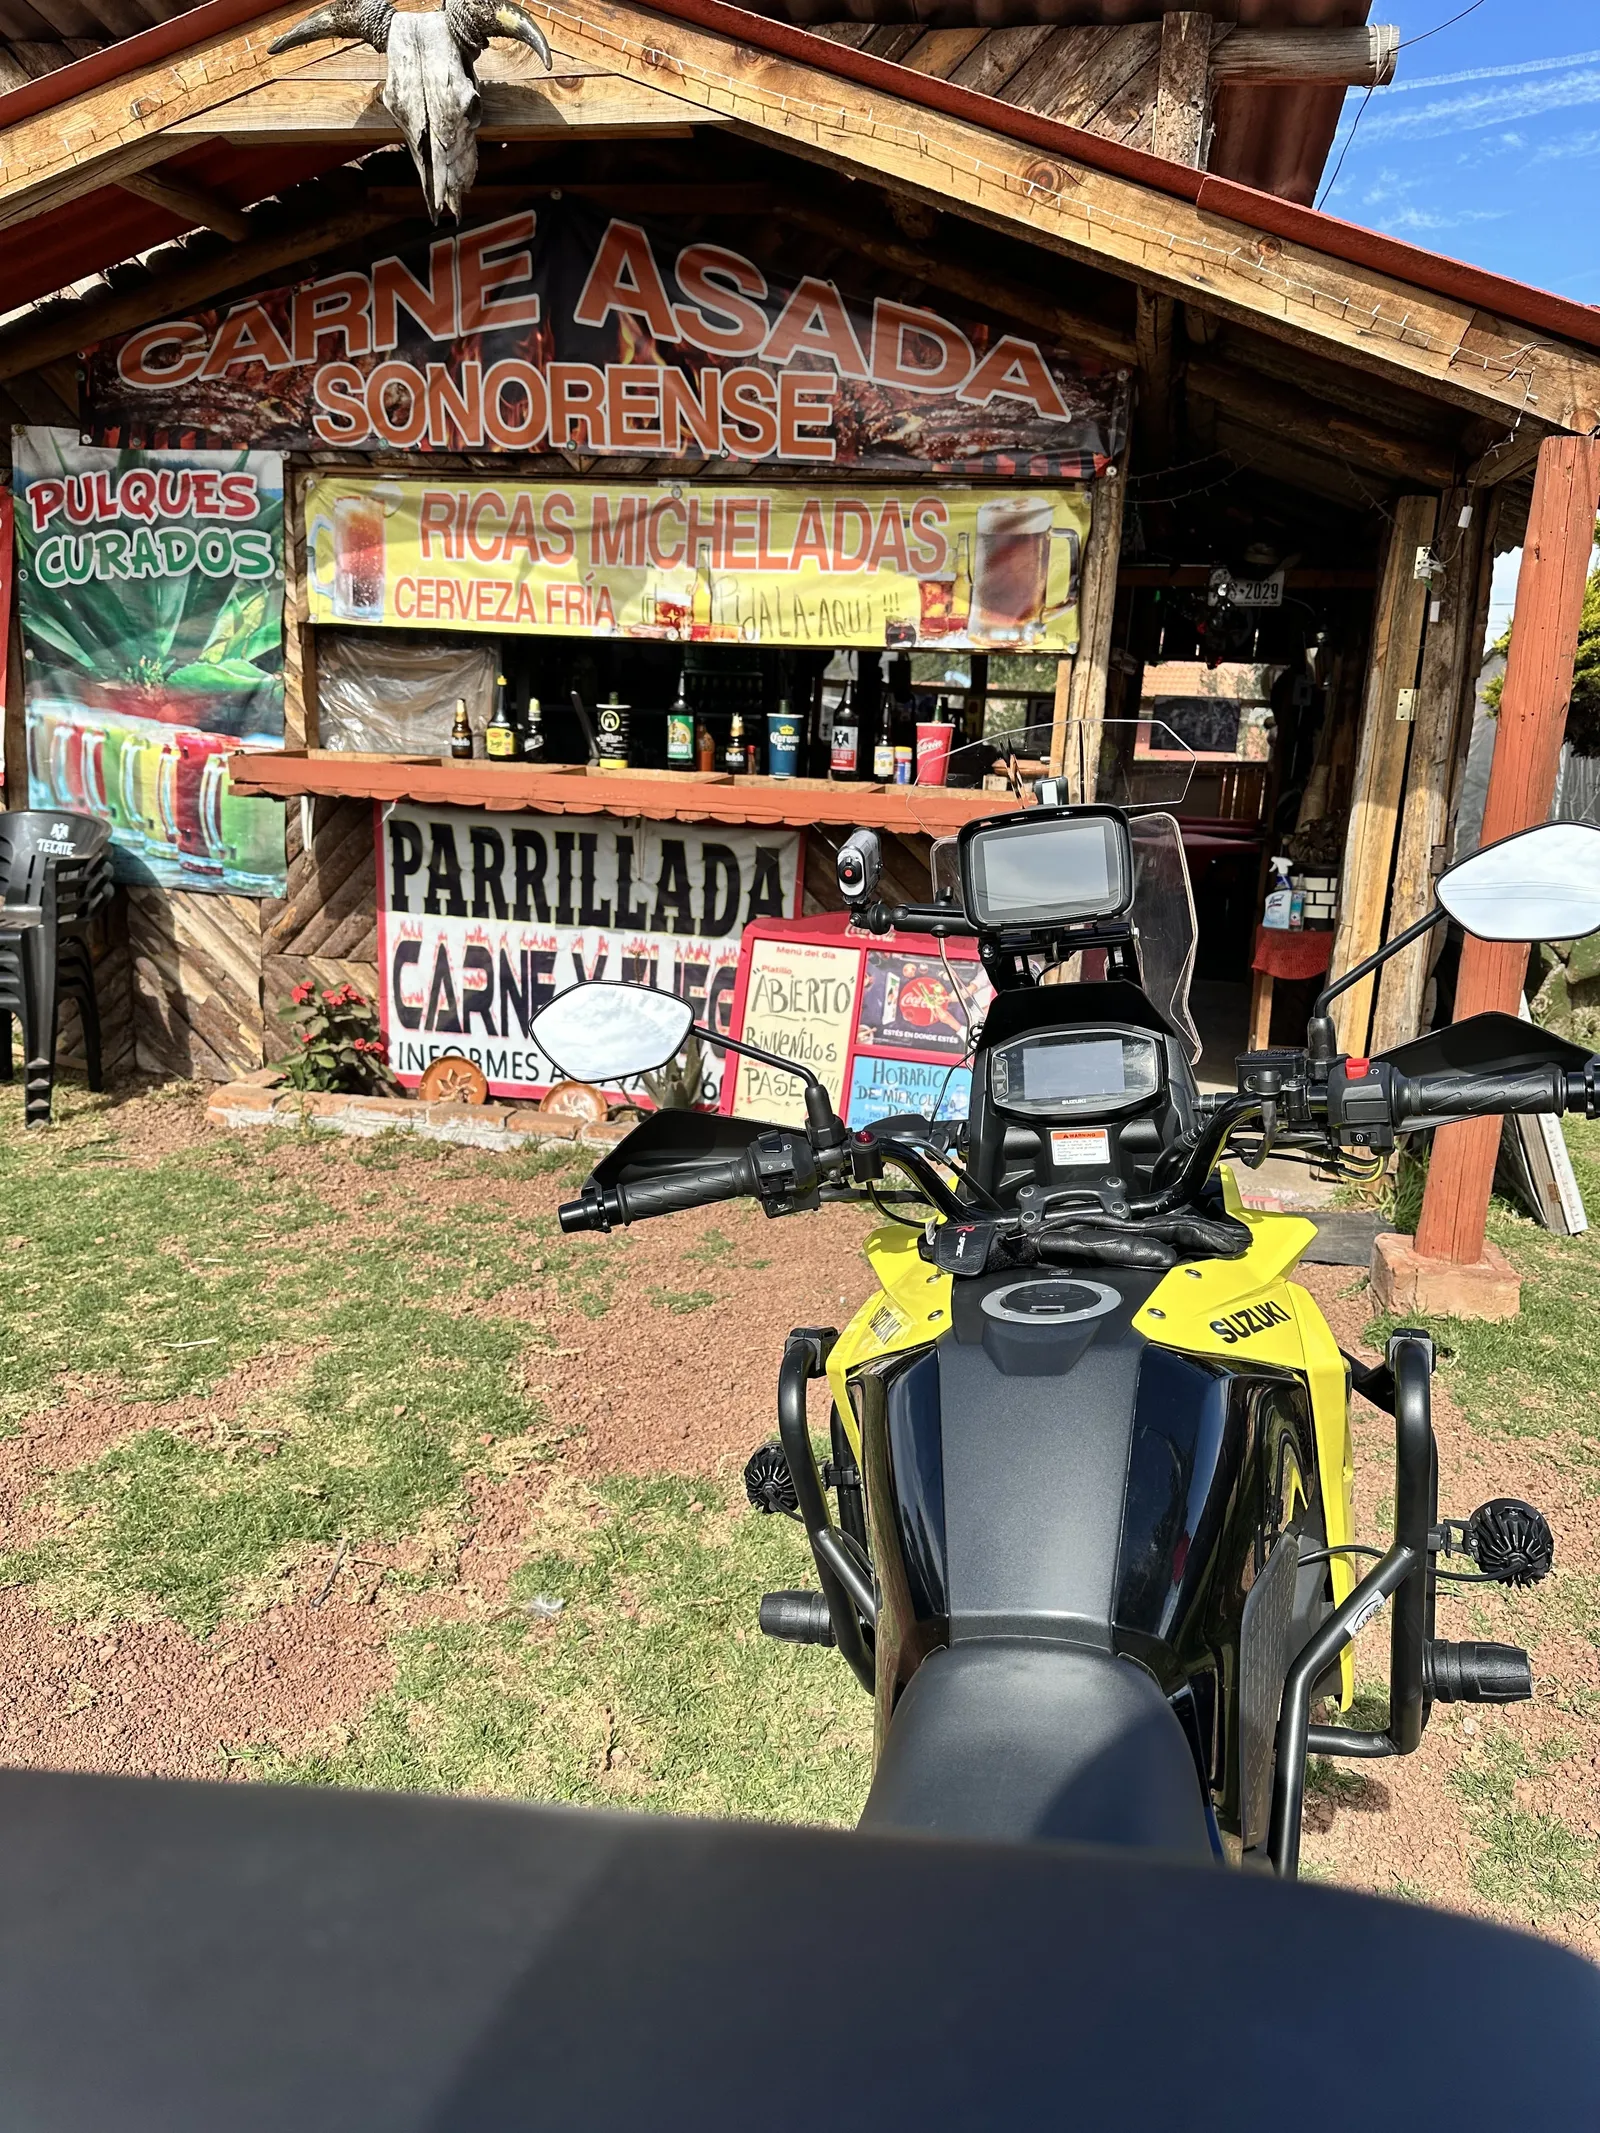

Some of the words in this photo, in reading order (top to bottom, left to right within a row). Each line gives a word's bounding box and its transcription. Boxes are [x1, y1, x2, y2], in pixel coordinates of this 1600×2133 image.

[117, 209, 540, 390] CARNE
[573, 217, 1071, 422] ASADA
[313, 359, 836, 461] SONORENSE
[26, 468, 260, 533] PULQUES
[35, 527, 274, 588] CURADOS
[418, 488, 576, 566] RICAS
[589, 492, 950, 575] MICHELADAS
[394, 577, 537, 624] CERVEZA
[545, 571, 618, 628] FRÍA
[36, 838, 77, 856] TECATE
[388, 819, 784, 938] PARRILLADA
[761, 964, 793, 975] Platillo
[804, 949, 819, 957] del
[392, 938, 557, 1040] CARNE
[883, 1028, 903, 1038] ESTÉS
[914, 1032, 937, 1042] DONDE
[938, 1035, 959, 1045] ESTÉS
[744, 1067, 823, 1098] PASE
[868, 1305, 903, 1346] SUZUKI
[1209, 1300, 1292, 1344] SUZUKI
